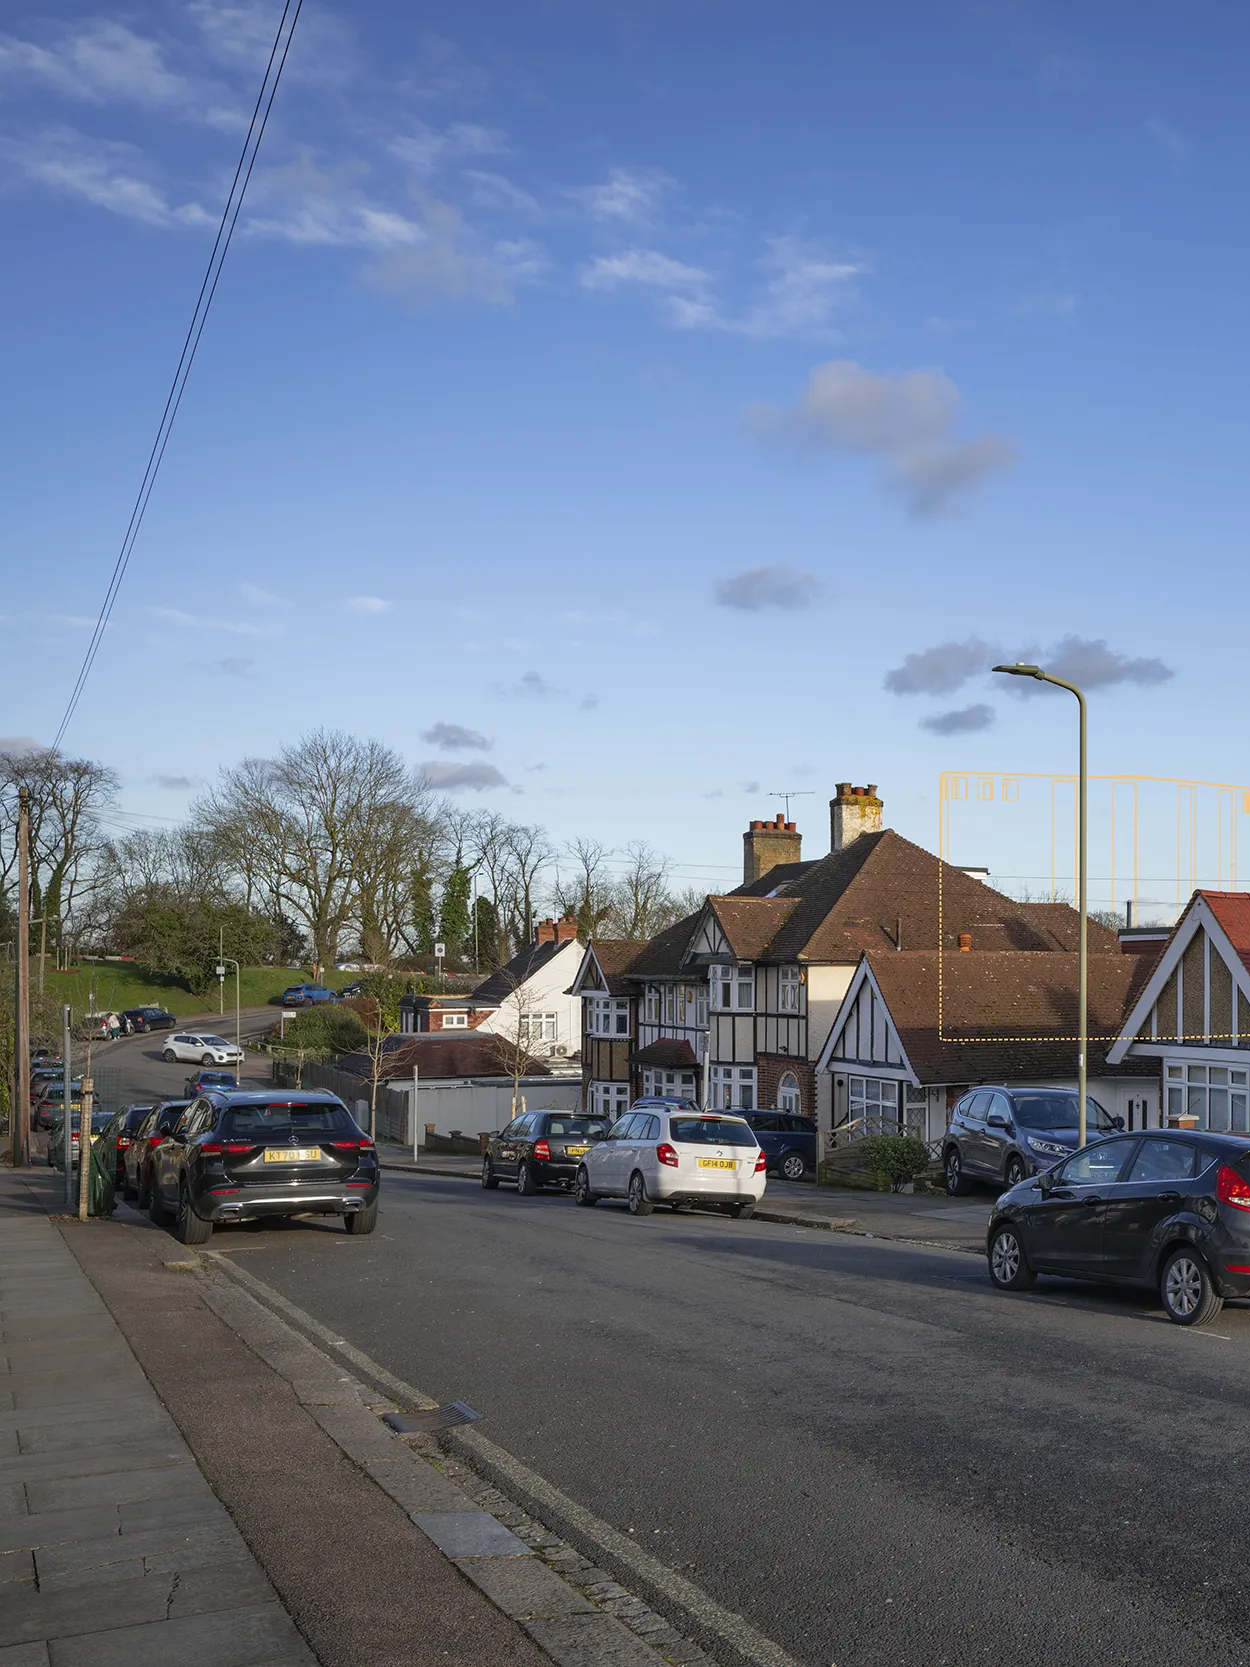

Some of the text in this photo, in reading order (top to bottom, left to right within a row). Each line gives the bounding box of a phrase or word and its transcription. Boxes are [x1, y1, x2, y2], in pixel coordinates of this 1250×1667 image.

[269, 1150, 317, 1160] KT70 SU
[702, 1160, 718, 1168] GF14
